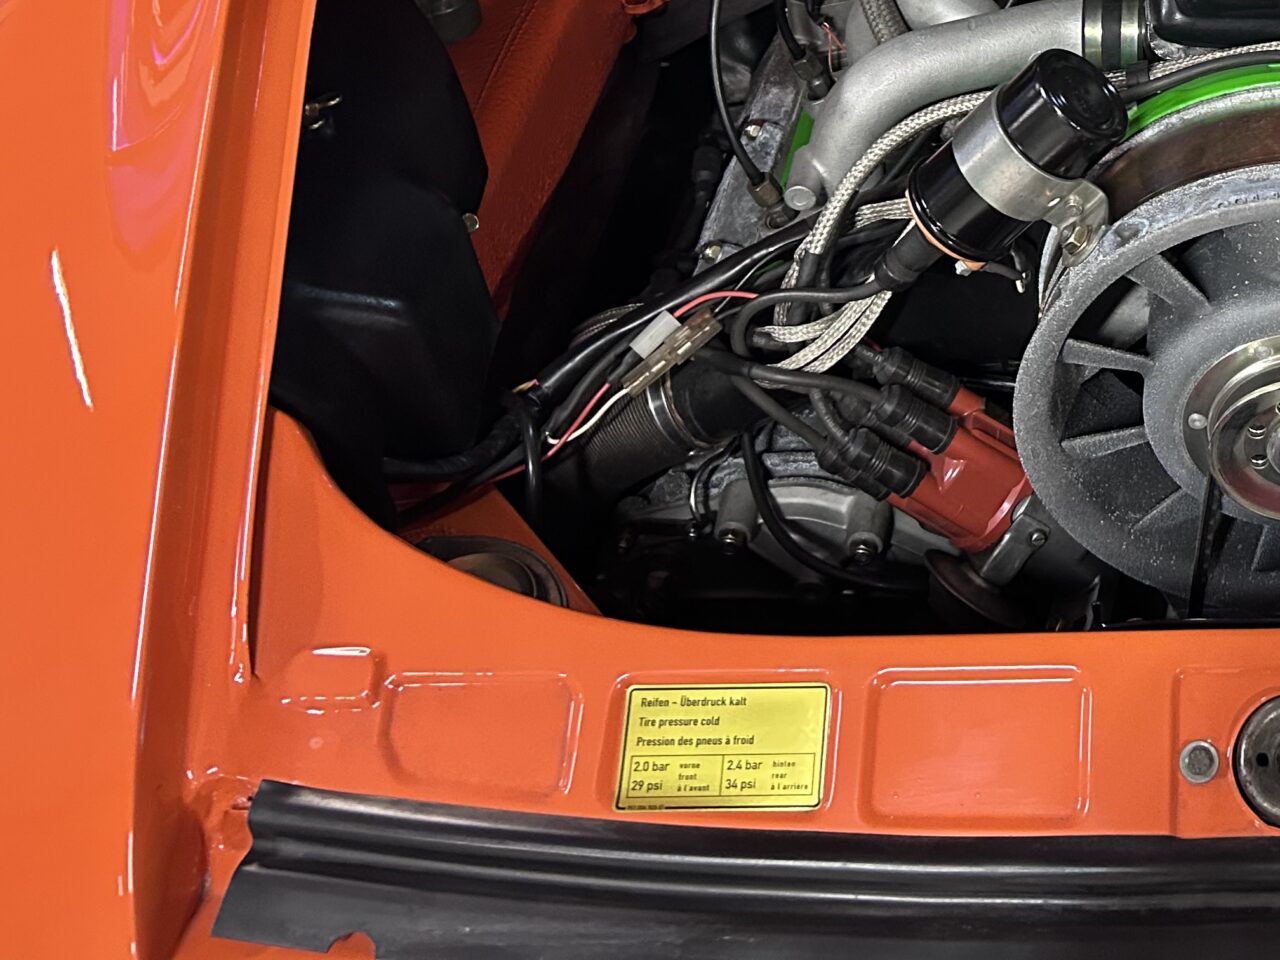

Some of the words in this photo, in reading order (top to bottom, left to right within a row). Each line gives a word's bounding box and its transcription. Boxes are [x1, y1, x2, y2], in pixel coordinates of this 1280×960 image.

[641, 698, 669, 707] Reifen
[680, 695, 726, 707] Überdruck
[729, 696, 747, 706] kalt
[639, 717, 656, 727] Tire
[659, 718, 698, 728] pressure
[701, 716, 720, 726] cold
[636, 736, 675, 746] Pression
[678, 736, 695, 746] des
[696, 737, 723, 747] pneus
[733, 735, 754, 745] froid
[633, 761, 650, 772] 2.0
[652, 761, 670, 772] bar
[727, 760, 742, 770] 2.4
[745, 760, 763, 770] bar
[631, 780, 644, 791] 29
[646, 780, 663, 793] psi
[725, 779, 738, 789] 34
[740, 778, 756, 791] psi
